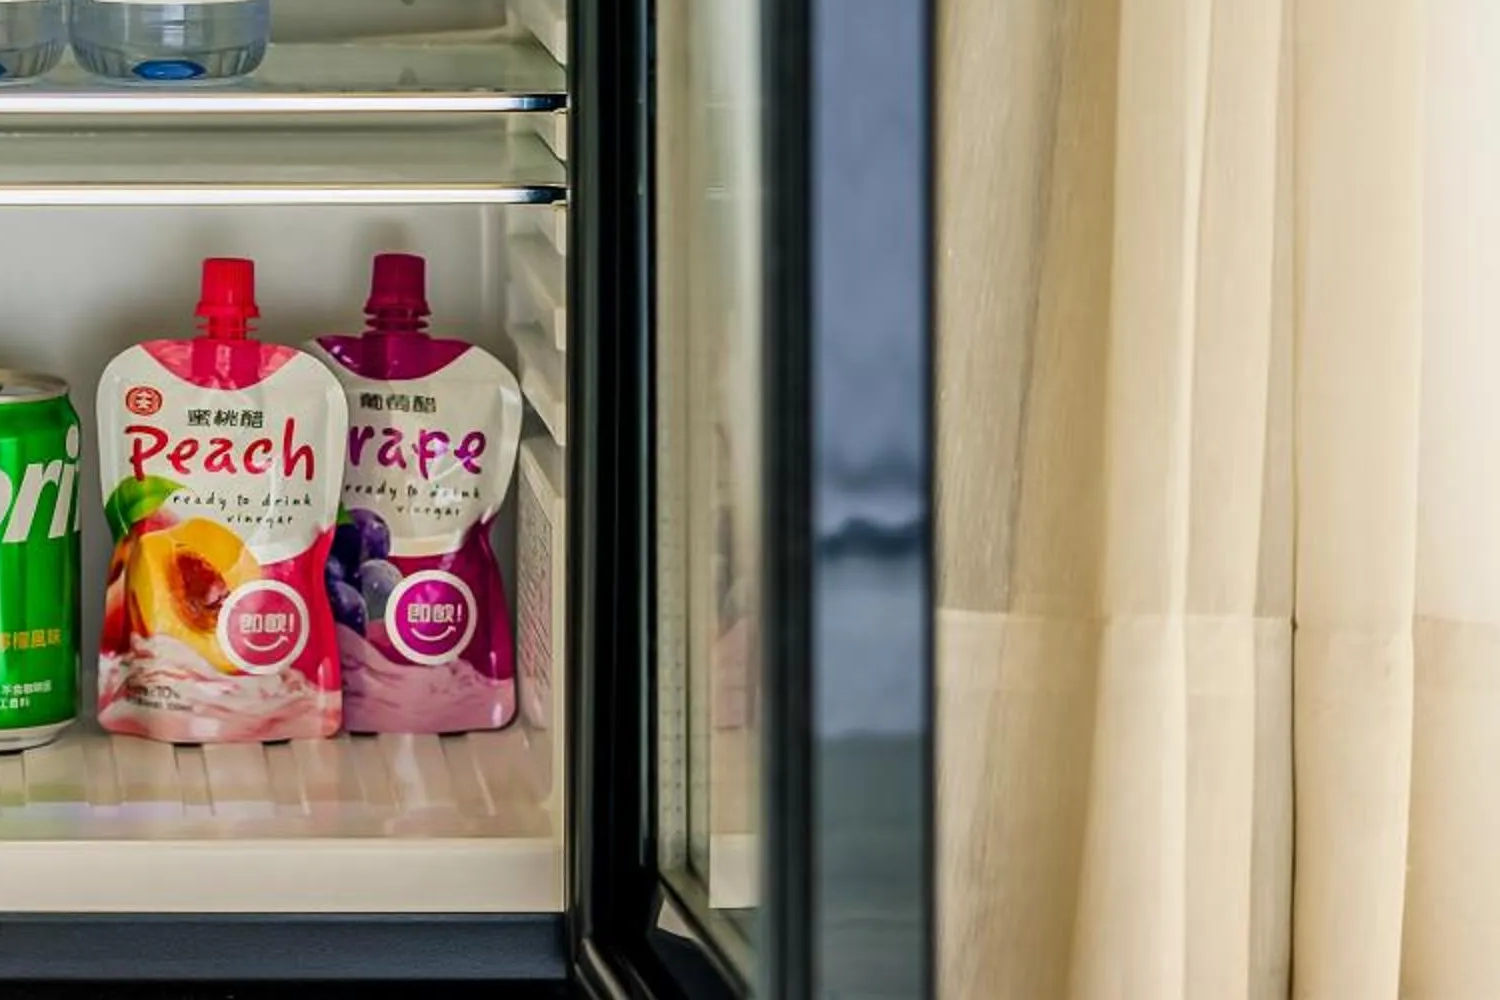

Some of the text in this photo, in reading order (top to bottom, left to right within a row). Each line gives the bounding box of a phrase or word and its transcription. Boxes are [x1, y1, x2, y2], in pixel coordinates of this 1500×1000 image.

[123, 417, 316, 482] Peach
[348, 425, 487, 481] rape
[345, 480, 397, 501] ready
[407, 484, 419, 497] to
[173, 492, 313, 511] ready to drink
[226, 514, 294, 528] vinegar
